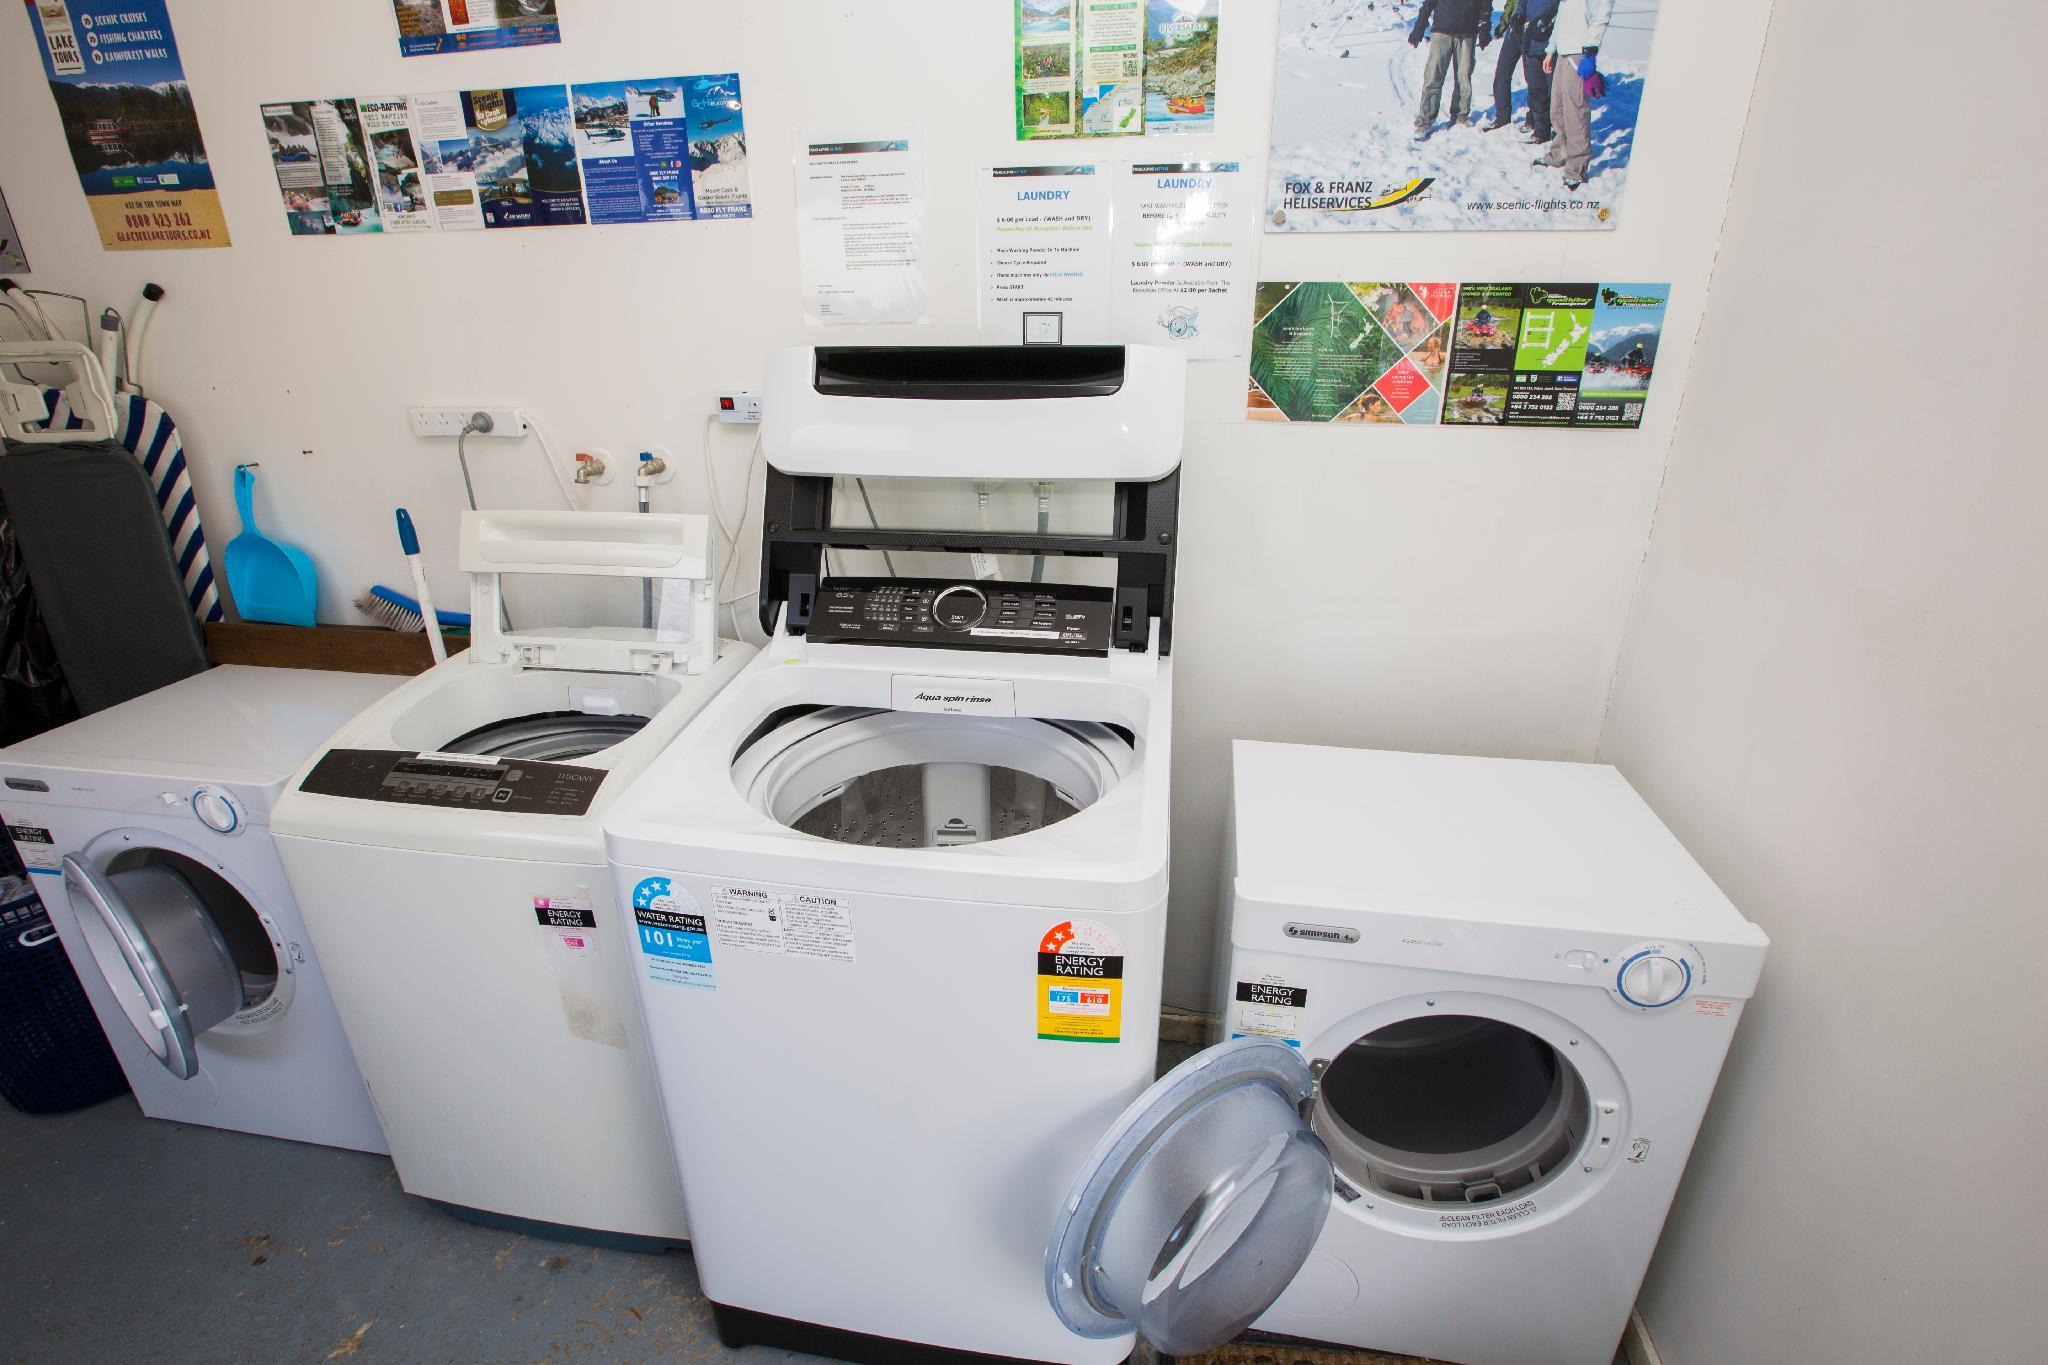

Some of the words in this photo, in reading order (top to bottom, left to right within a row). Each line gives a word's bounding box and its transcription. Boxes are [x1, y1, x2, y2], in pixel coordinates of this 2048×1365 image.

[95, 14, 118, 26] SCENIC
[120, 12, 148, 24] CRUISES
[49, 35, 74, 49] LAKE
[100, 33, 126, 44] FISHING
[128, 30, 163, 41] CHARTERS
[53, 51, 79, 64] TOURS
[105, 50, 144, 62] RAINFOREST
[146, 48, 167, 59] WALKS
[473, 91, 498, 105] Scenic
[367, 102, 408, 112] ECO-RAFTING
[1158, 178, 1212, 188] LAUNDRY
[1285, 182, 1311, 195] FOX
[1314, 182, 1325, 194] &
[1328, 181, 1373, 194] FRANZ
[1018, 190, 1070, 200] LAUNDRY
[1283, 196, 1372, 210] HELISERVICES
[728, 205, 747, 213] FRANZ
[125, 213, 151, 228] 0800
[152, 213, 171, 227] 423
[173, 212, 192, 226] 262
[915, 693, 941, 701] Aqua
[20, 834, 46, 842] RATING
[729, 888, 768, 899] WARNING
[800, 896, 837, 906] CAUTION
[548, 910, 581, 919] ENERGY
[637, 910, 667, 922] WATER
[669, 915, 702, 927] RATING
[550, 918, 583, 926] RATING
[644, 929, 673, 947] 101
[1055, 956, 1105, 967] ENERGY
[1056, 965, 1104, 976] RATING
[1251, 985, 1295, 996] ENERGY
[1252, 994, 1292, 1005] RATING
[1496, 1208, 1514, 1216] EACH
[1515, 1200, 1534, 1211] LOAD
